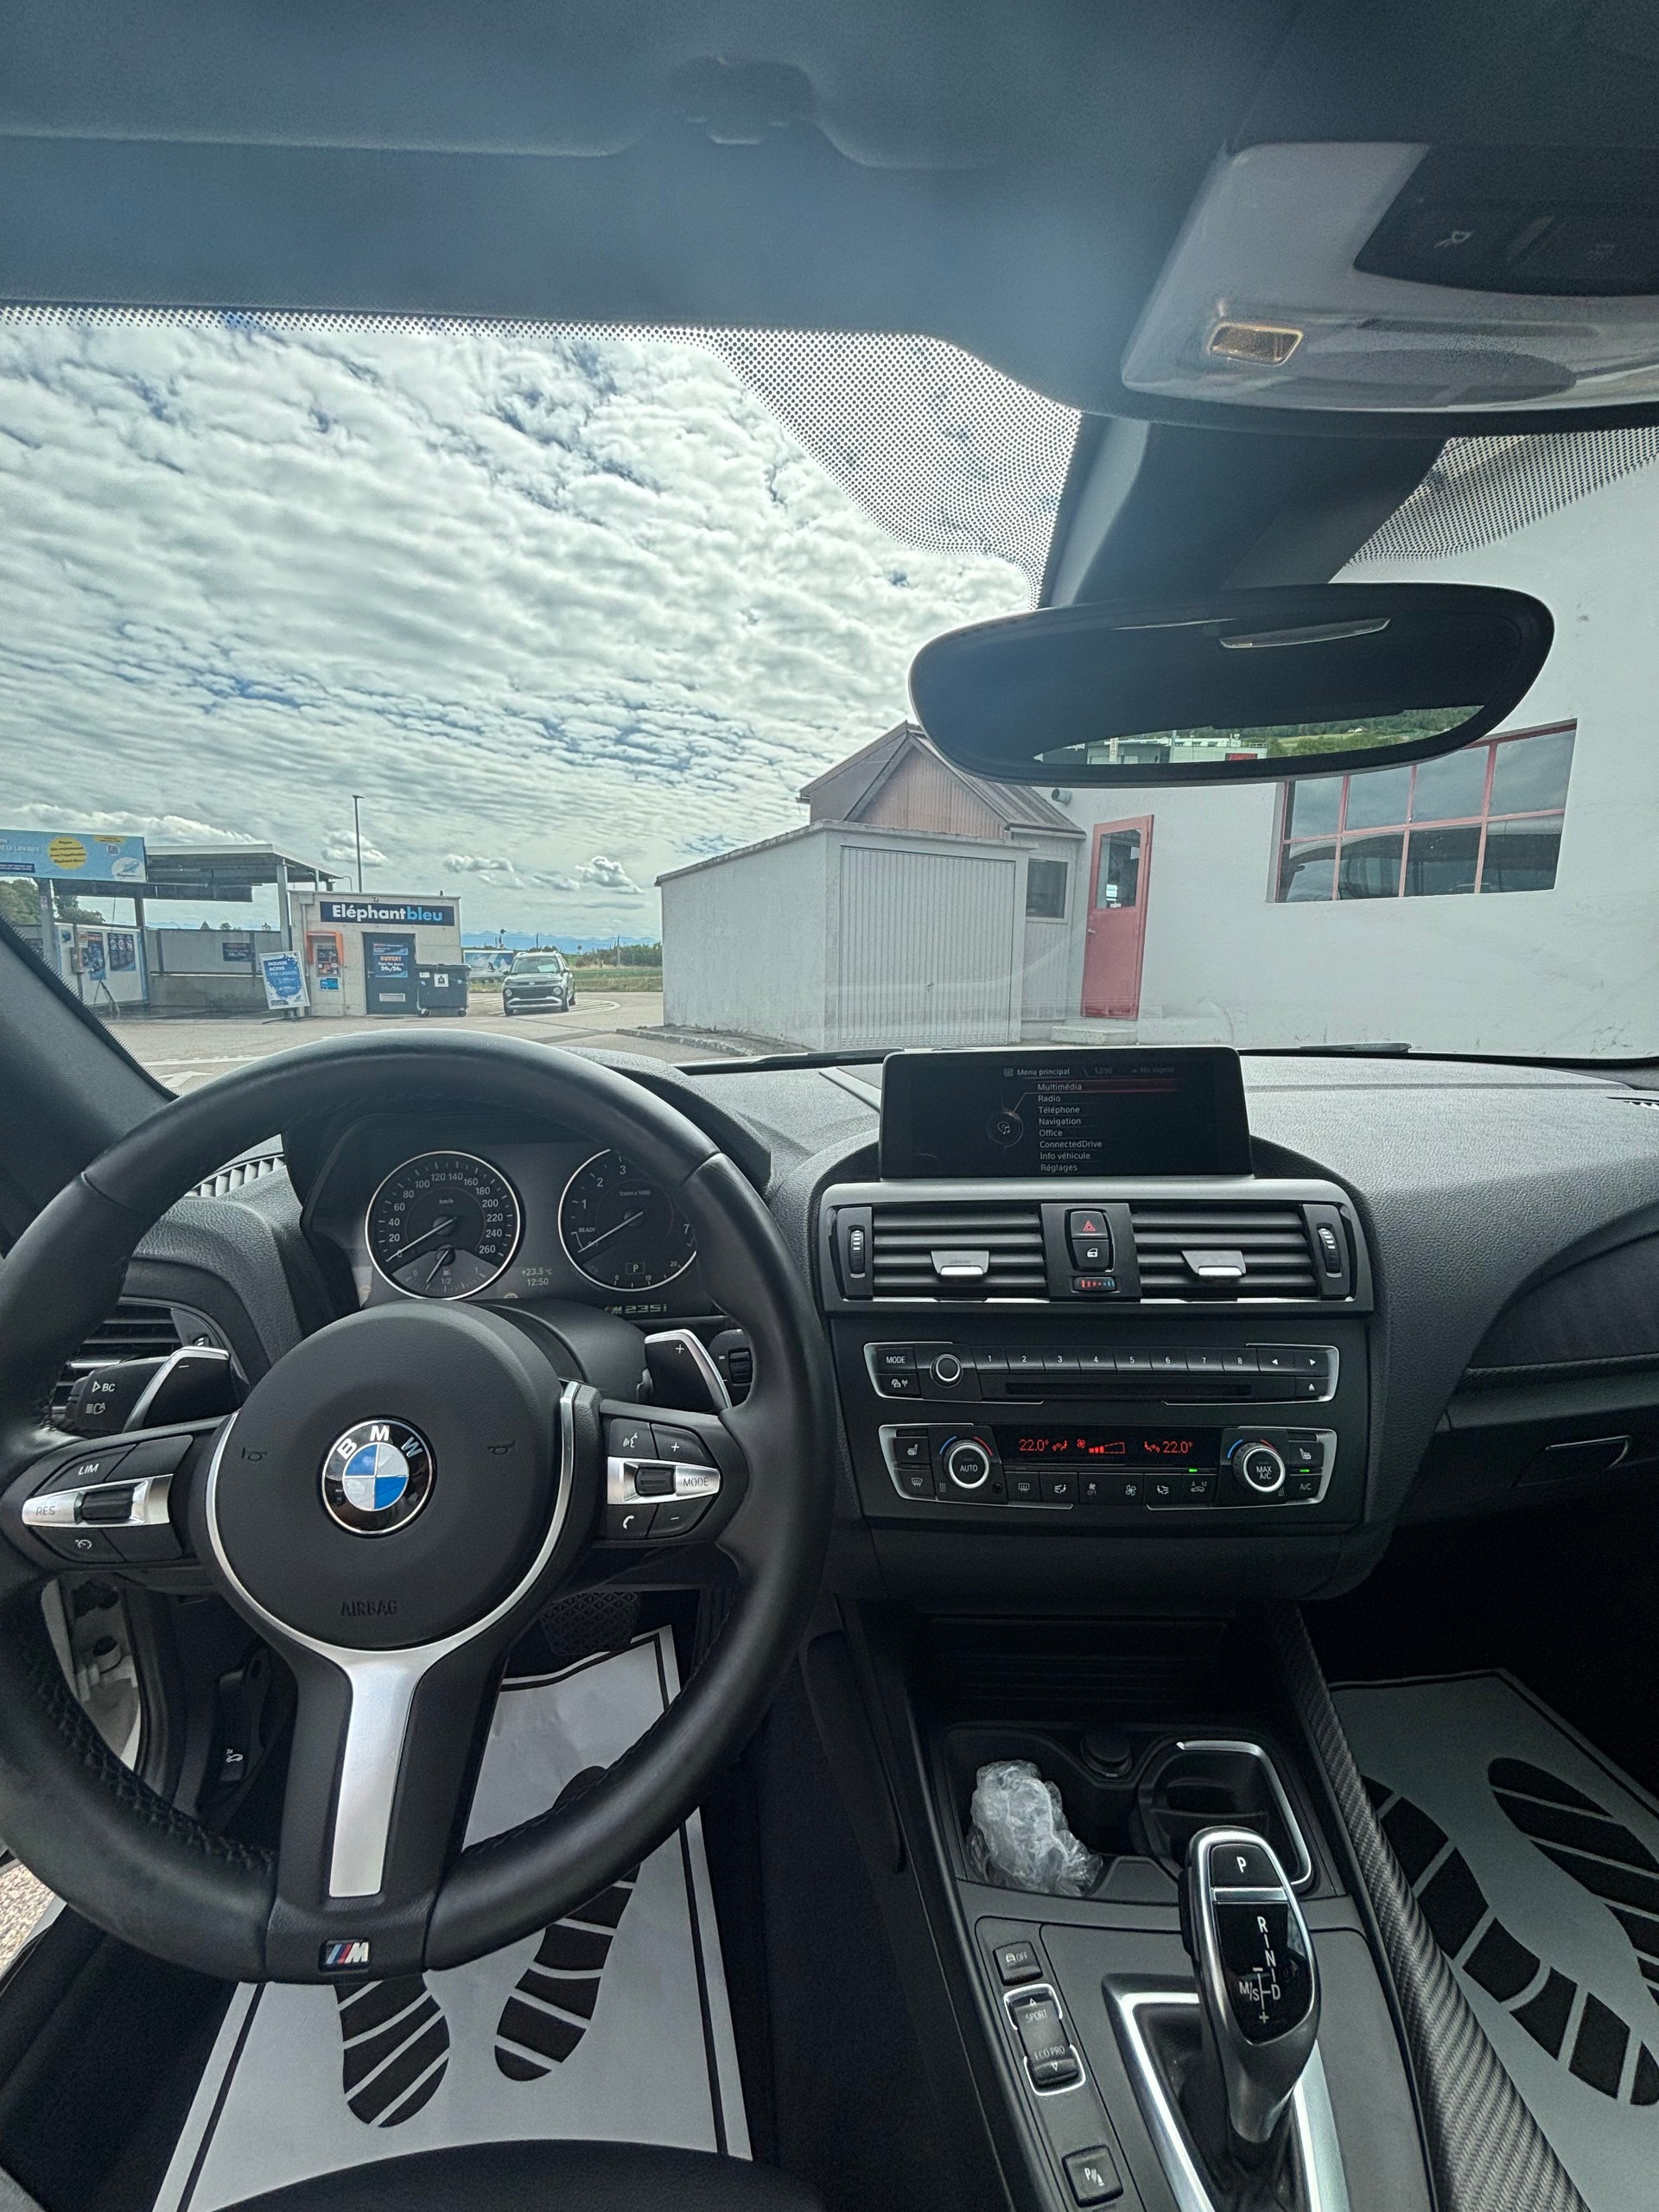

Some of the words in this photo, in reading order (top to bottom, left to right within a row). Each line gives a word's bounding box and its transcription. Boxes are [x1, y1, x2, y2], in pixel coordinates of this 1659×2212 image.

[1039, 1068, 1070, 1077] principal
[1152, 1066, 1174, 1075] signal
[1038, 1083, 1082, 1091] Multimédia
[1039, 1106, 1080, 1115] Téléphone
[1039, 1118, 1081, 1127] Navigation
[1039, 1152, 1056, 1160] Info
[620, 1165, 626, 1175] 3
[1040, 1164, 1078, 1173] Réglages
[463, 1178, 479, 1186] 160
[596, 1178, 604, 1187] 2
[403, 1190, 415, 1198] 80
[475, 1186, 491, 1195] 180
[394, 1202, 405, 1211] 60
[482, 1198, 499, 1208] 200
[582, 1199, 587, 1209] 1
[389, 1217, 400, 1226] 40
[486, 1213, 504, 1223] 220
[486, 1229, 503, 1238] 240
[683, 1224, 690, 1234] 7
[389, 1233, 400, 1243] 20
[479, 1244, 496, 1254] 260
[527, 1278, 550, 1287] 12:50
[102, 1383, 116, 1392] BC
[336, 1425, 423, 1460] BMW
[78, 1463, 99, 1476] LIM
[683, 1477, 709, 1487] MODE
[35, 1505, 55, 1516] RES
[340, 1599, 398, 1617] AIRBAG
[1236, 1856, 1247, 1873] P
[1256, 1916, 1268, 1933] R
[1015, 1951, 1028, 1962] OFF
[1265, 1949, 1276, 1967] N
[1271, 1984, 1281, 2000] D
[1025, 2009, 1048, 2023] SPORT
[1033, 2050, 1051, 2061] ECO
[1051, 2045, 1065, 2056] PRO
